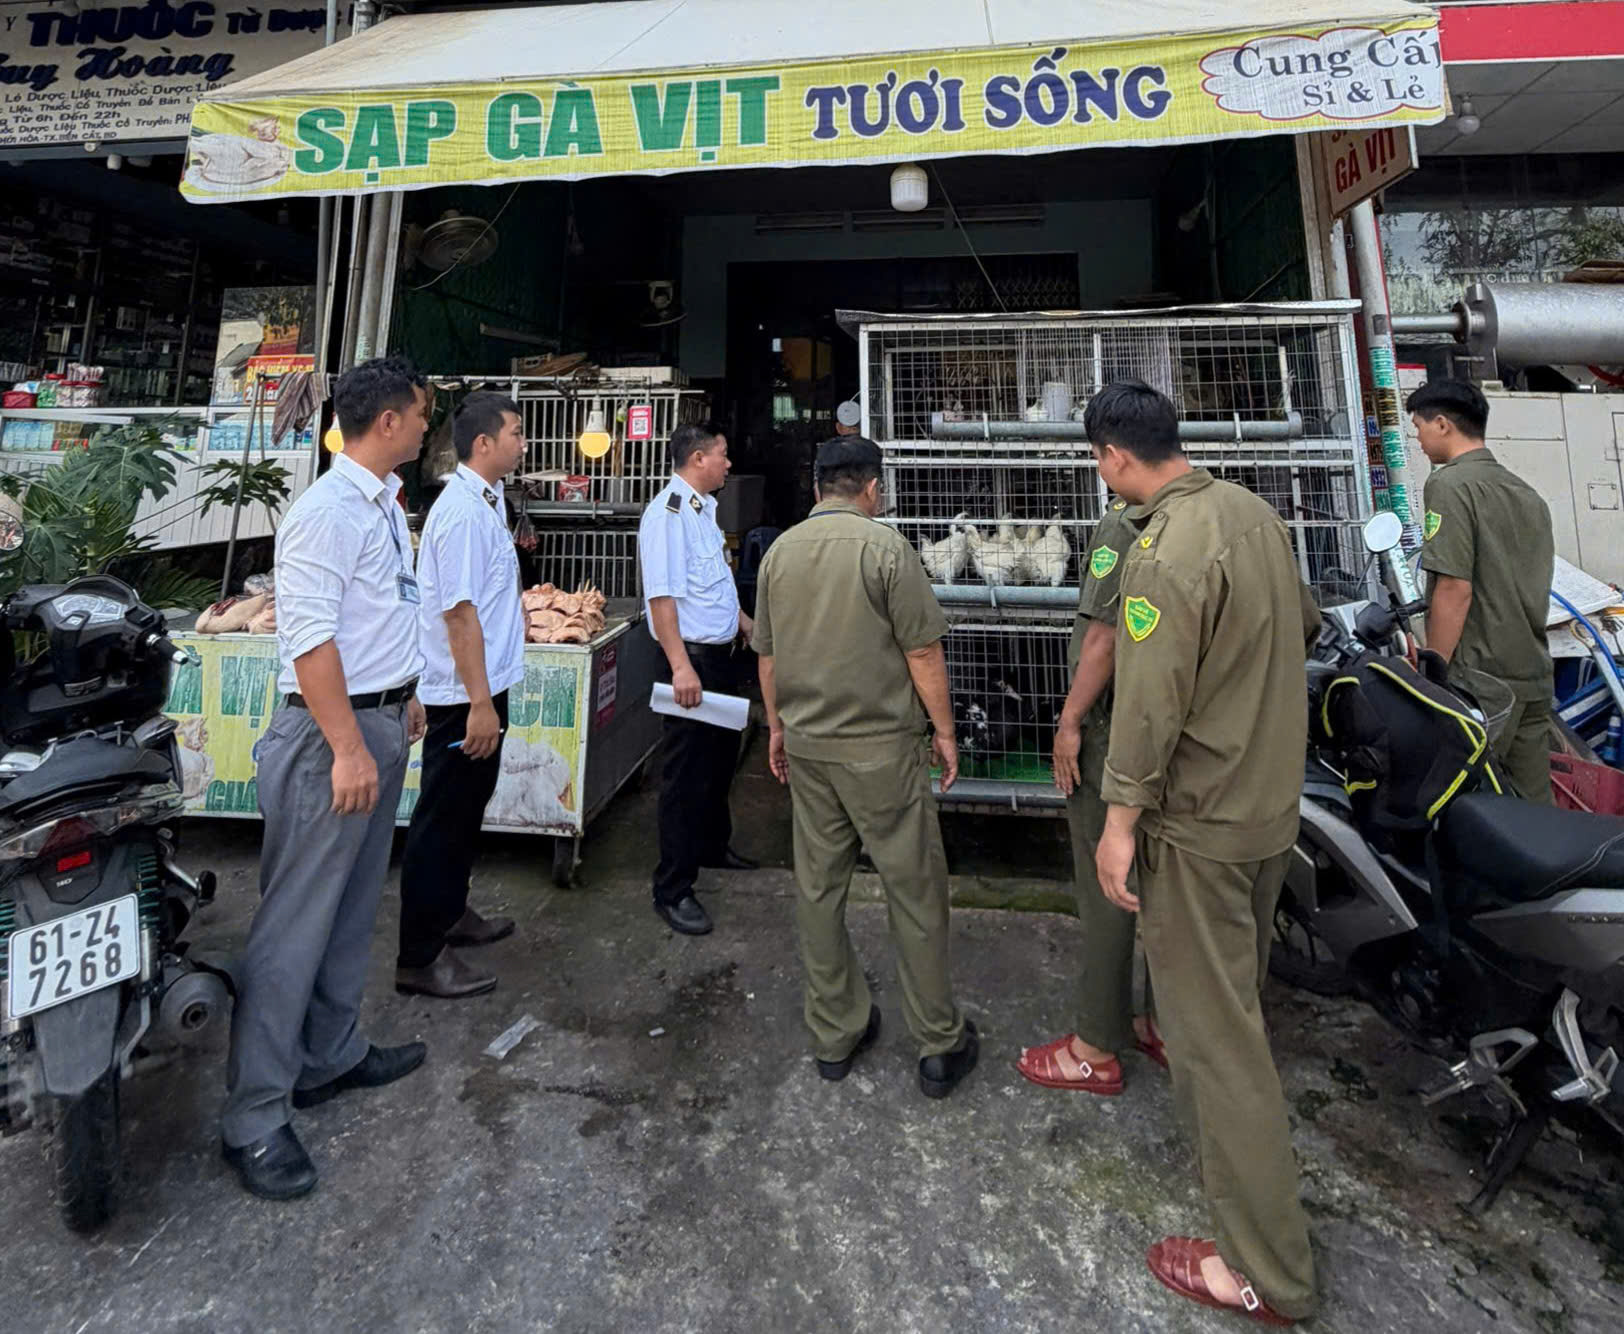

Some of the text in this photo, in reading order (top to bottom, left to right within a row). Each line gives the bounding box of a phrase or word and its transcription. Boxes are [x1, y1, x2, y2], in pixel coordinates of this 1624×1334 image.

[75, 46, 235, 82] Hoàng
[1233, 46, 1354, 78] Cung
[152, 84, 193, 96] Dược
[1302, 75, 1425, 107] Sỉ & Lẻ
[94, 111, 121, 120] 22h
[294, 46, 1172, 183] SẠP GÀ VỊT TƯƠI SỐNG
[1335, 127, 1396, 193] GÀ VỊT
[163, 644, 203, 713] À
[29, 905, 121, 966] 61-Z4
[28, 942, 122, 1009] 7268
